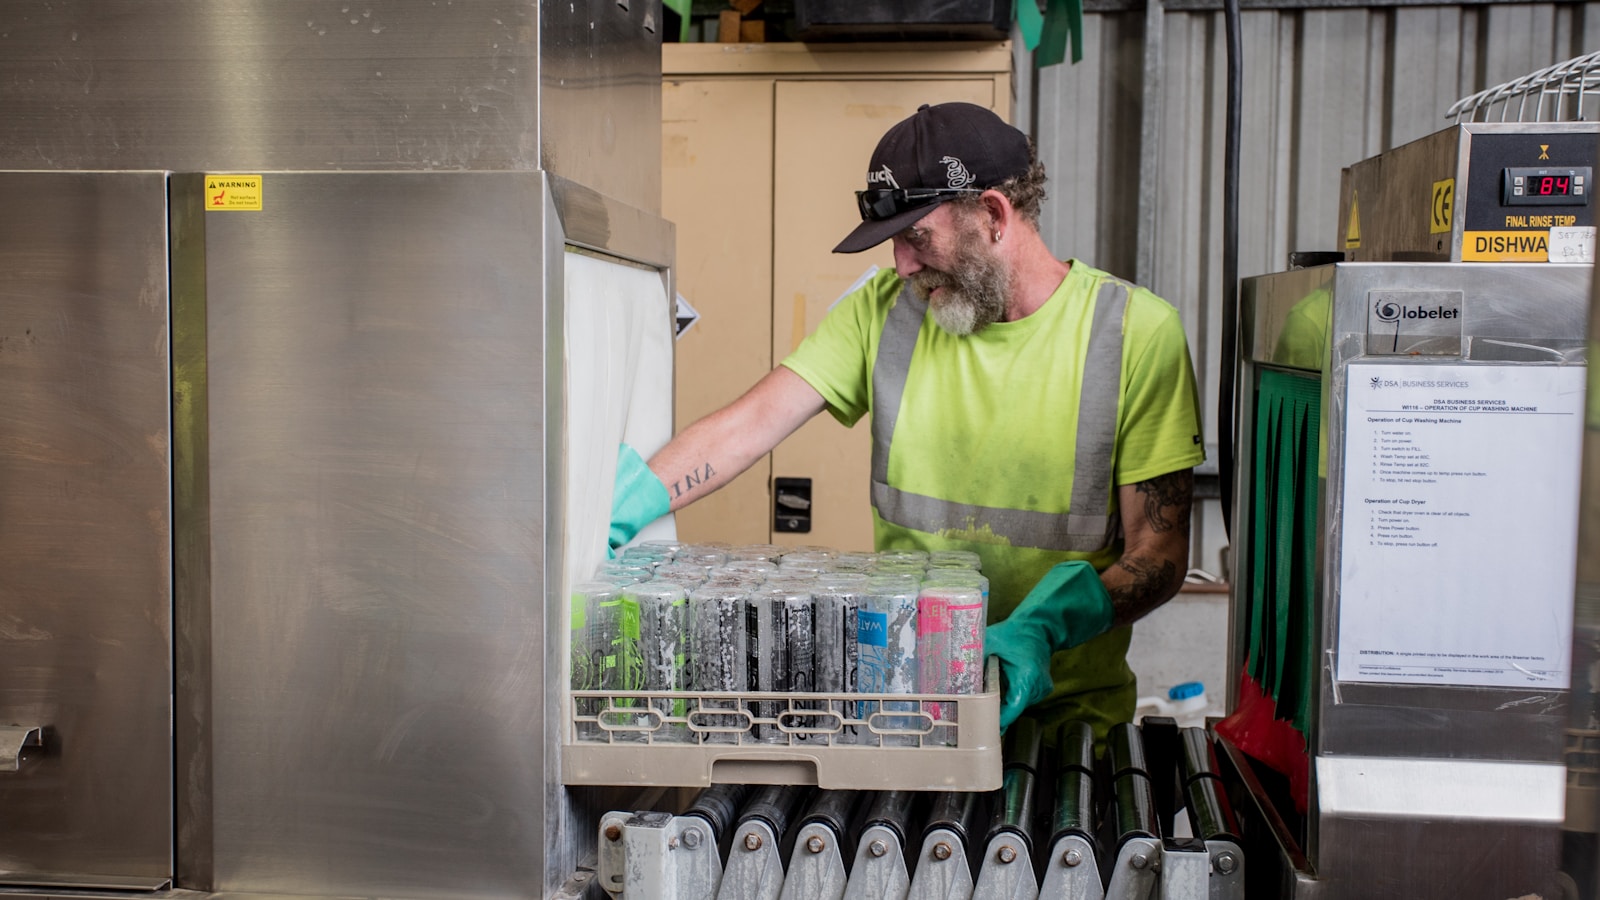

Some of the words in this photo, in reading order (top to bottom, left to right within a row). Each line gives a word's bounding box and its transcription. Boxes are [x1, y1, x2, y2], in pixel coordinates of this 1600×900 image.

[1540, 177, 1569, 195] 84
[1433, 186, 1451, 226] CE
[1506, 216, 1528, 227] FINAL
[1530, 216, 1553, 227] RINSE
[1554, 215, 1576, 226] TEMP
[670, 462, 716, 502] INA
